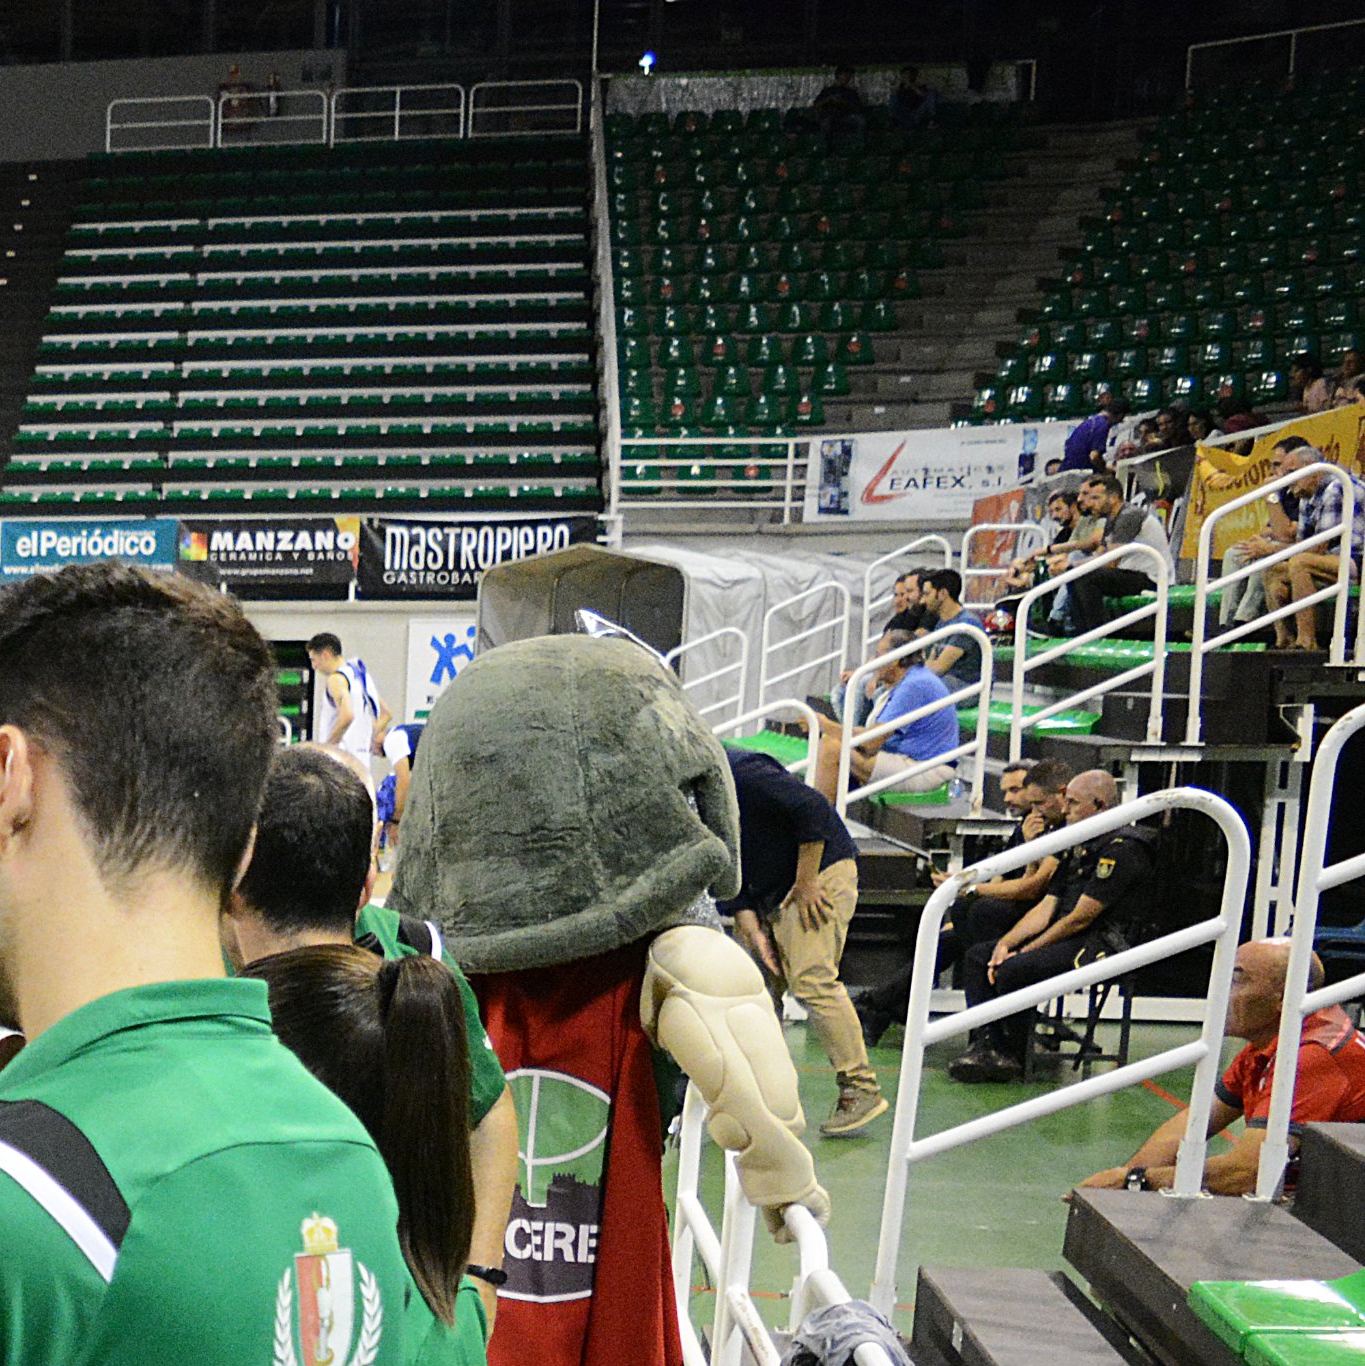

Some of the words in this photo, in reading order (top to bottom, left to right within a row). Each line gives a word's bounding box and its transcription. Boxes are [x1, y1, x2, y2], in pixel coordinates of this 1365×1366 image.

[210, 530, 356, 551] MANZANO
[292, 553, 301, 561] Y
[505, 1218, 599, 1264] CERE
